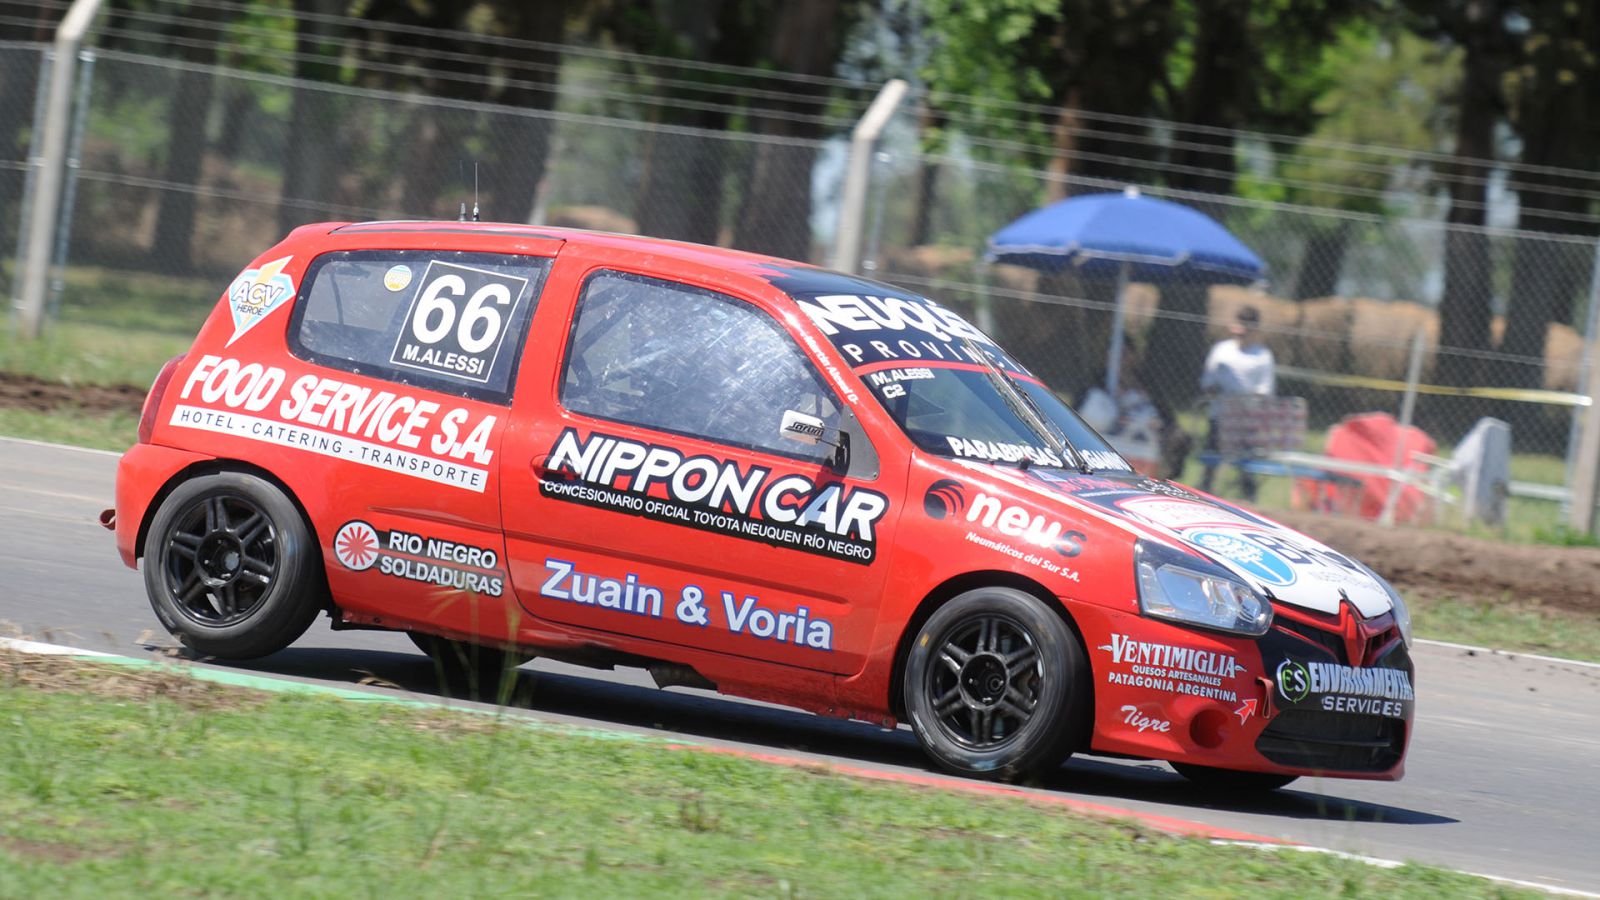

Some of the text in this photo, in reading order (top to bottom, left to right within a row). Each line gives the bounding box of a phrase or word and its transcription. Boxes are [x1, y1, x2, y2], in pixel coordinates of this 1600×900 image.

[230, 281, 285, 308] ACV
[236, 304, 265, 316] HEROE
[412, 274, 511, 354] 66
[797, 294, 1003, 352] NEUQUÉ
[402, 344, 486, 375] M.ALESSI
[180, 354, 498, 465] FOOD SERVICE S.A.
[882, 383, 907, 399] C2
[180, 410, 234, 429] HOTEL
[252, 422, 343, 453] CATERING
[361, 447, 480, 486] TRANSPORTE
[946, 436, 1064, 468] PARABRISAS
[547, 430, 886, 542] NIPPON CAR
[544, 481, 872, 560] CONCESIONARIO OFICIAL TOYOTA NEUQUEN RÍO NEGRO
[965, 492, 1088, 558] neus
[388, 531, 497, 570] RIO NEGRO
[964, 531, 1080, 583] Neumáticos del Sur S.A.
[380, 555, 502, 598] SOLDADURAS
[540, 558, 833, 651] Zuain & Voria
[1110, 633, 1236, 679] VENTIMIGLIA
[1132, 664, 1222, 687] QUESOS ARTESANALES
[1108, 672, 1237, 702] PATAGONIA ARGENTINA
[1322, 696, 1403, 716] SERVICES
[1120, 704, 1171, 733] Tigre
